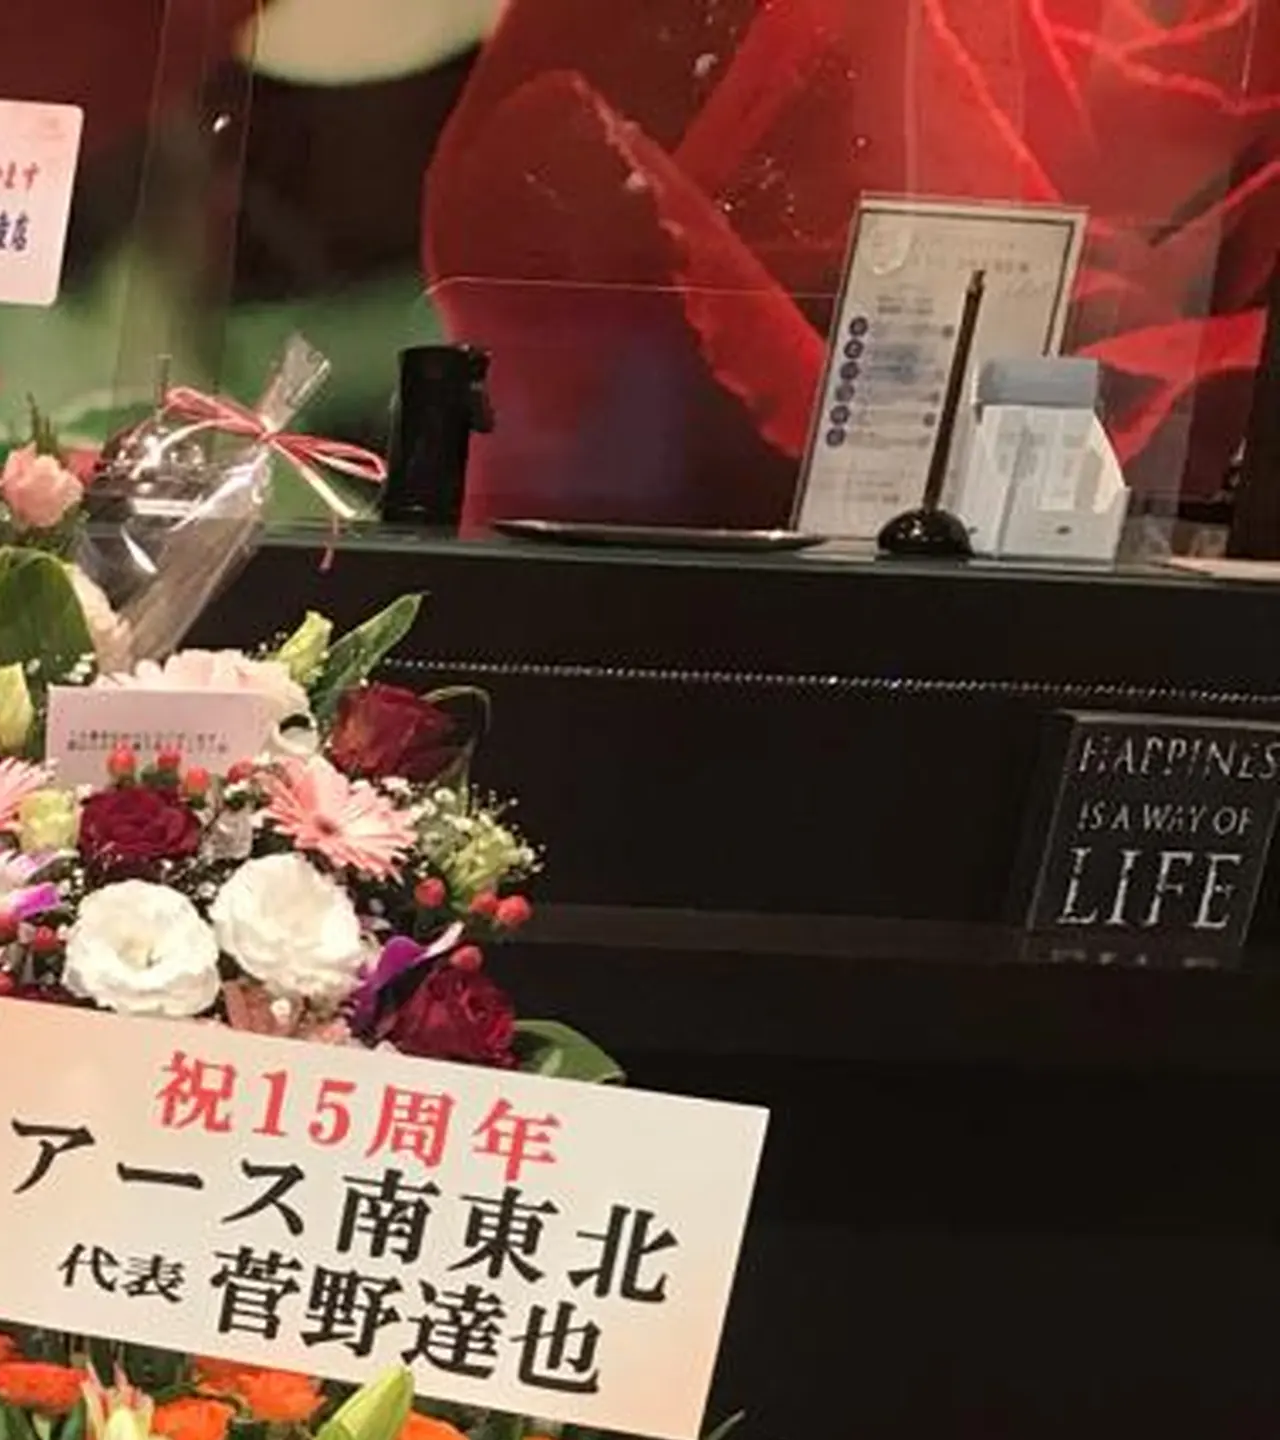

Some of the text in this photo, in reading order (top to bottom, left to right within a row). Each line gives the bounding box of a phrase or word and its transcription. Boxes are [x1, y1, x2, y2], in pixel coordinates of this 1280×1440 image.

[1076, 800, 1255, 836] IS A WAY OF
[1056, 847, 1242, 929] LIFE
[153, 1049, 565, 1184] 祝15周年
[9, 1115, 680, 1305] アース南東北
[56, 1240, 604, 1394] 代表 菅野達也
